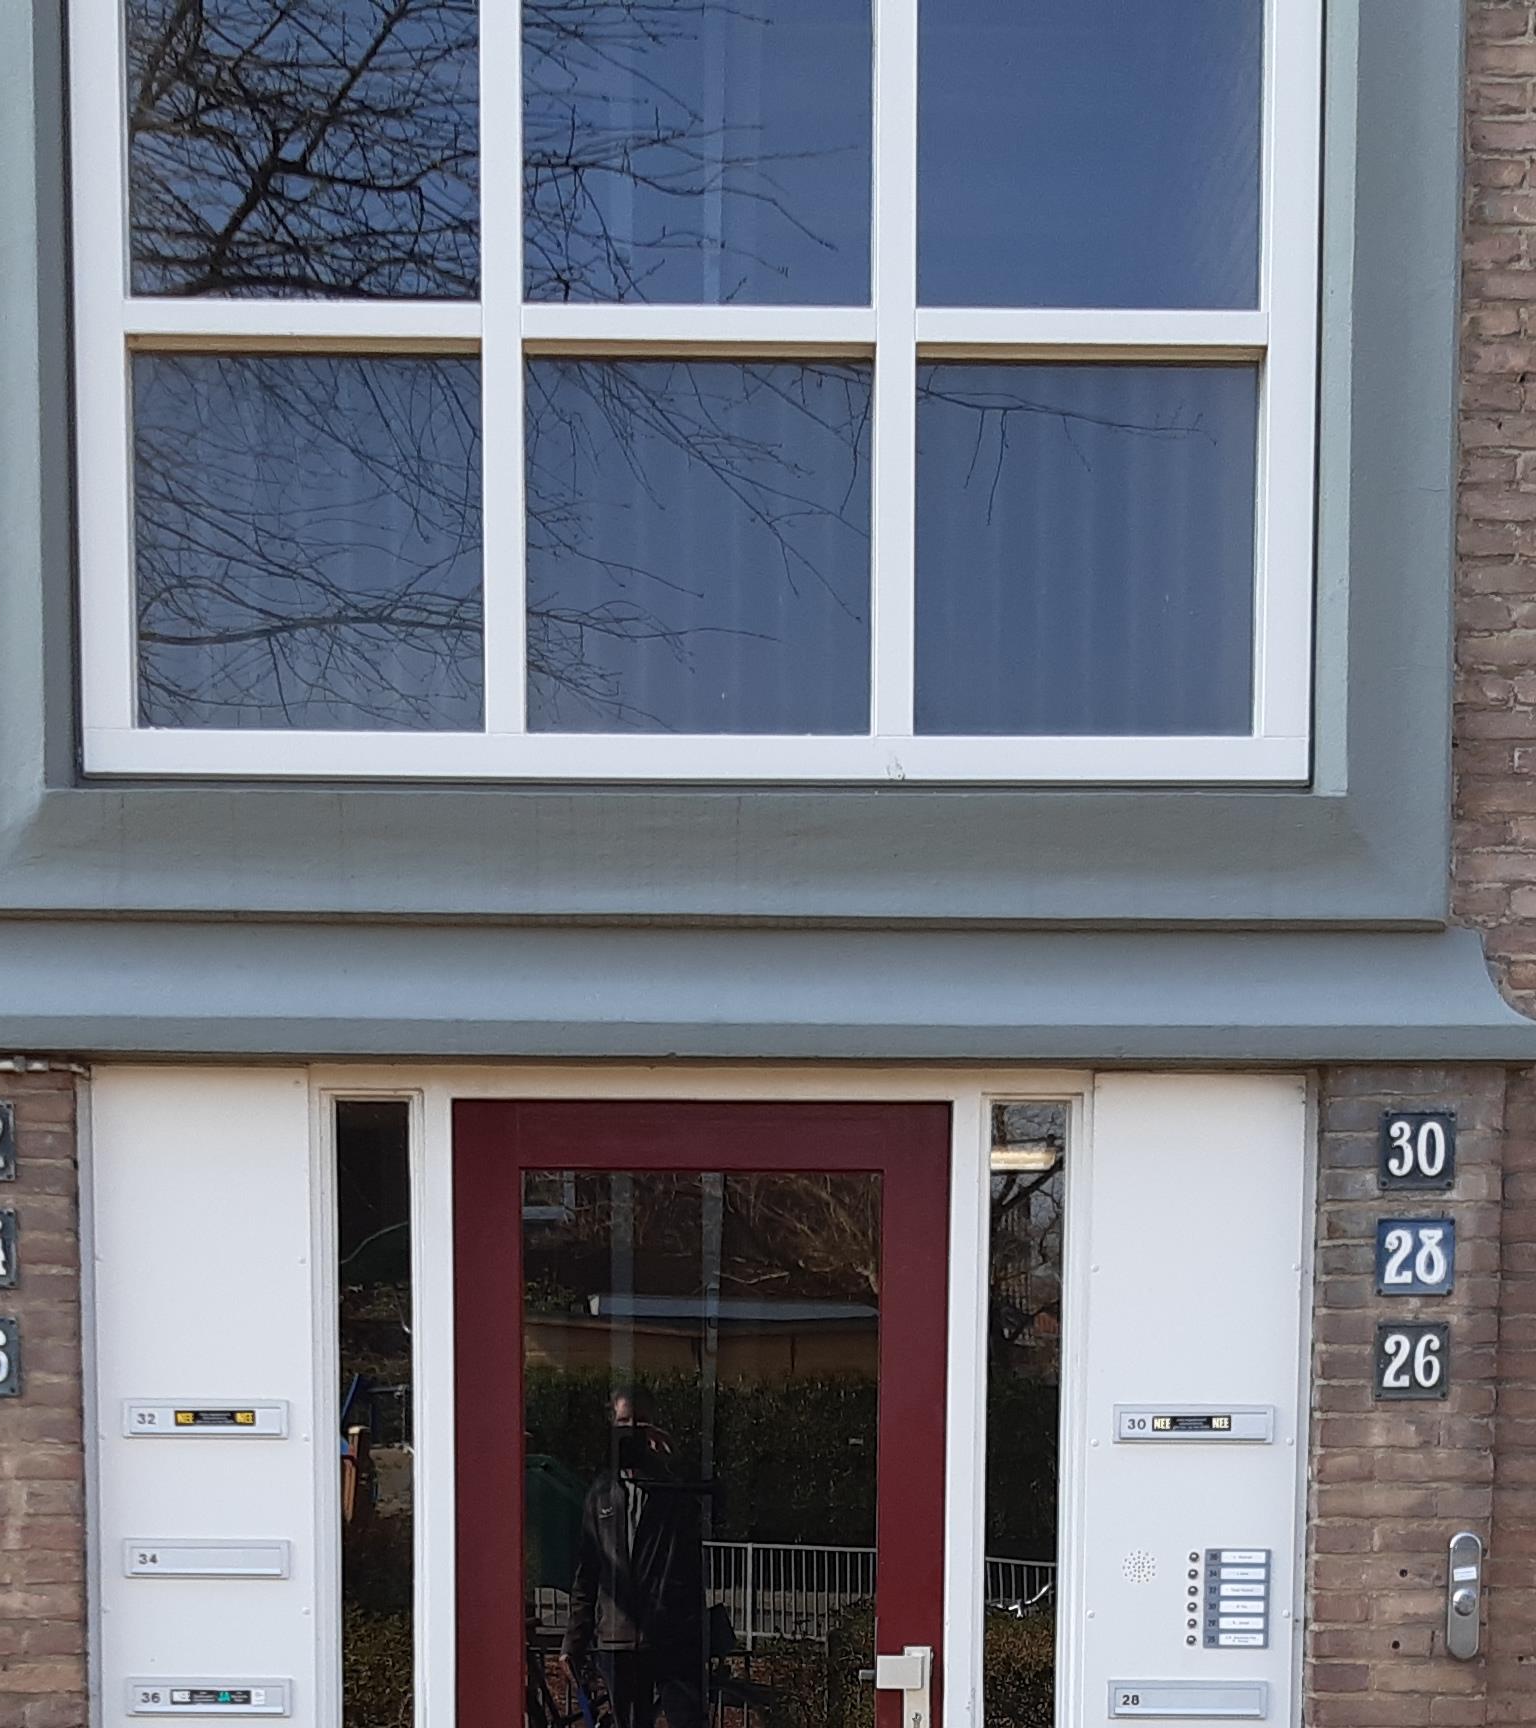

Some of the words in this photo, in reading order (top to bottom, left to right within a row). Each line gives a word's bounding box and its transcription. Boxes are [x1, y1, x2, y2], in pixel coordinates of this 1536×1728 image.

[1387, 1121, 1445, 1177] 30
[1383, 1229, 1447, 1284] 28
[1382, 1334, 1441, 1388] 26
[137, 1413, 156, 1425] 32
[1127, 1418, 1146, 1430] 30
[1153, 1417, 1171, 1430] NEE
[1212, 1416, 1230, 1429] NEE
[138, 1553, 158, 1565] 34
[141, 1692, 160, 1704] 36
[1122, 1694, 1140, 1706] 28
